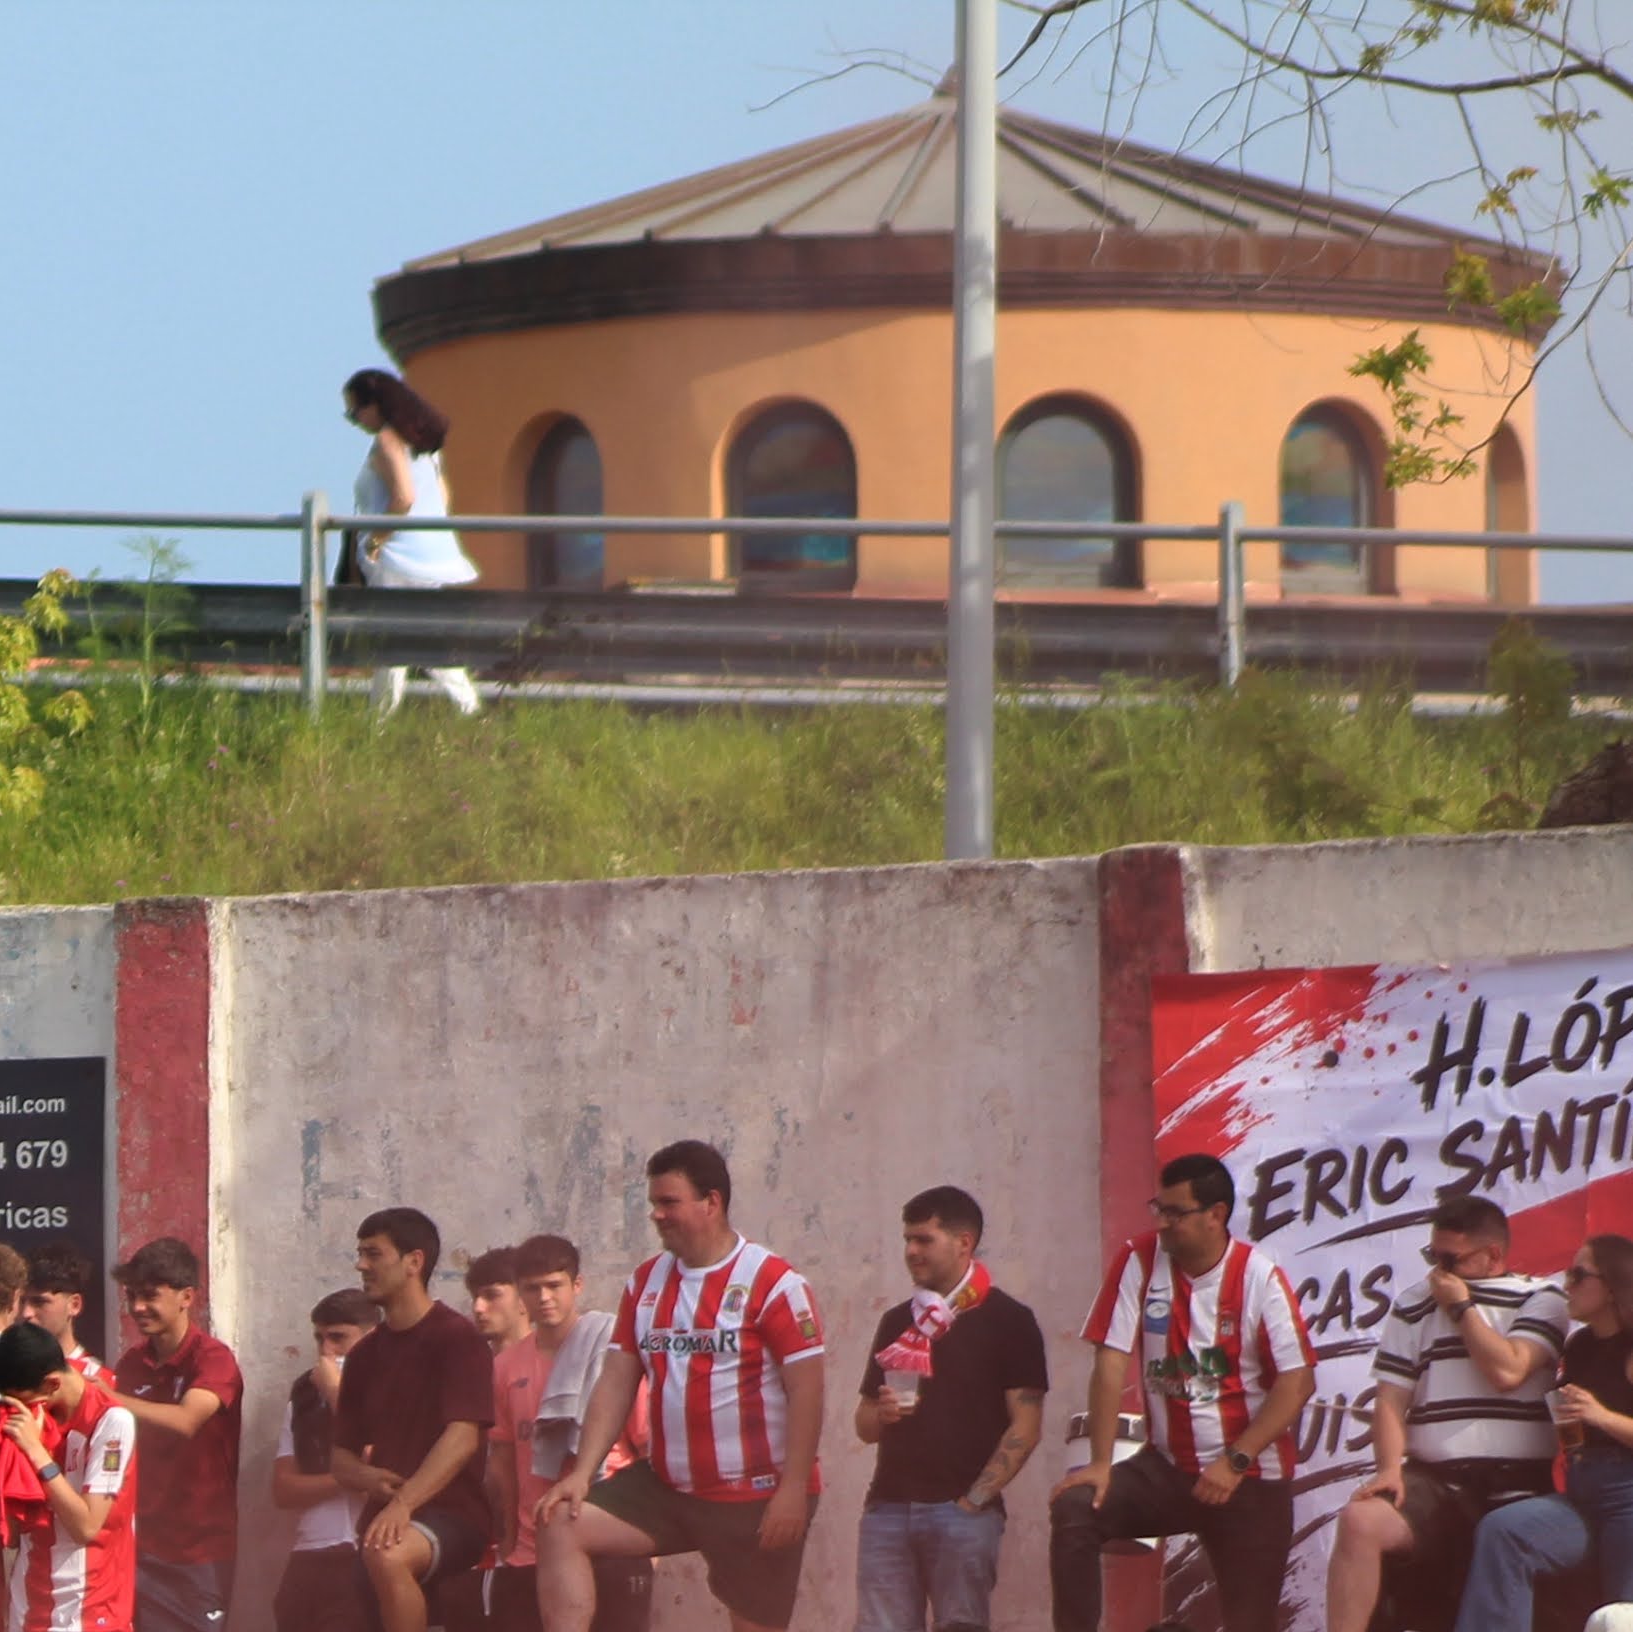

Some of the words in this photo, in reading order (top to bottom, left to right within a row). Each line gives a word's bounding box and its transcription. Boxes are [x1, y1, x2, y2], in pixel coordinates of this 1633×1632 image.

[15, 1139, 68, 1169] 679
[1247, 1137, 1414, 1242] ERIC
[1436, 1076, 1633, 1201] SANTÍ
